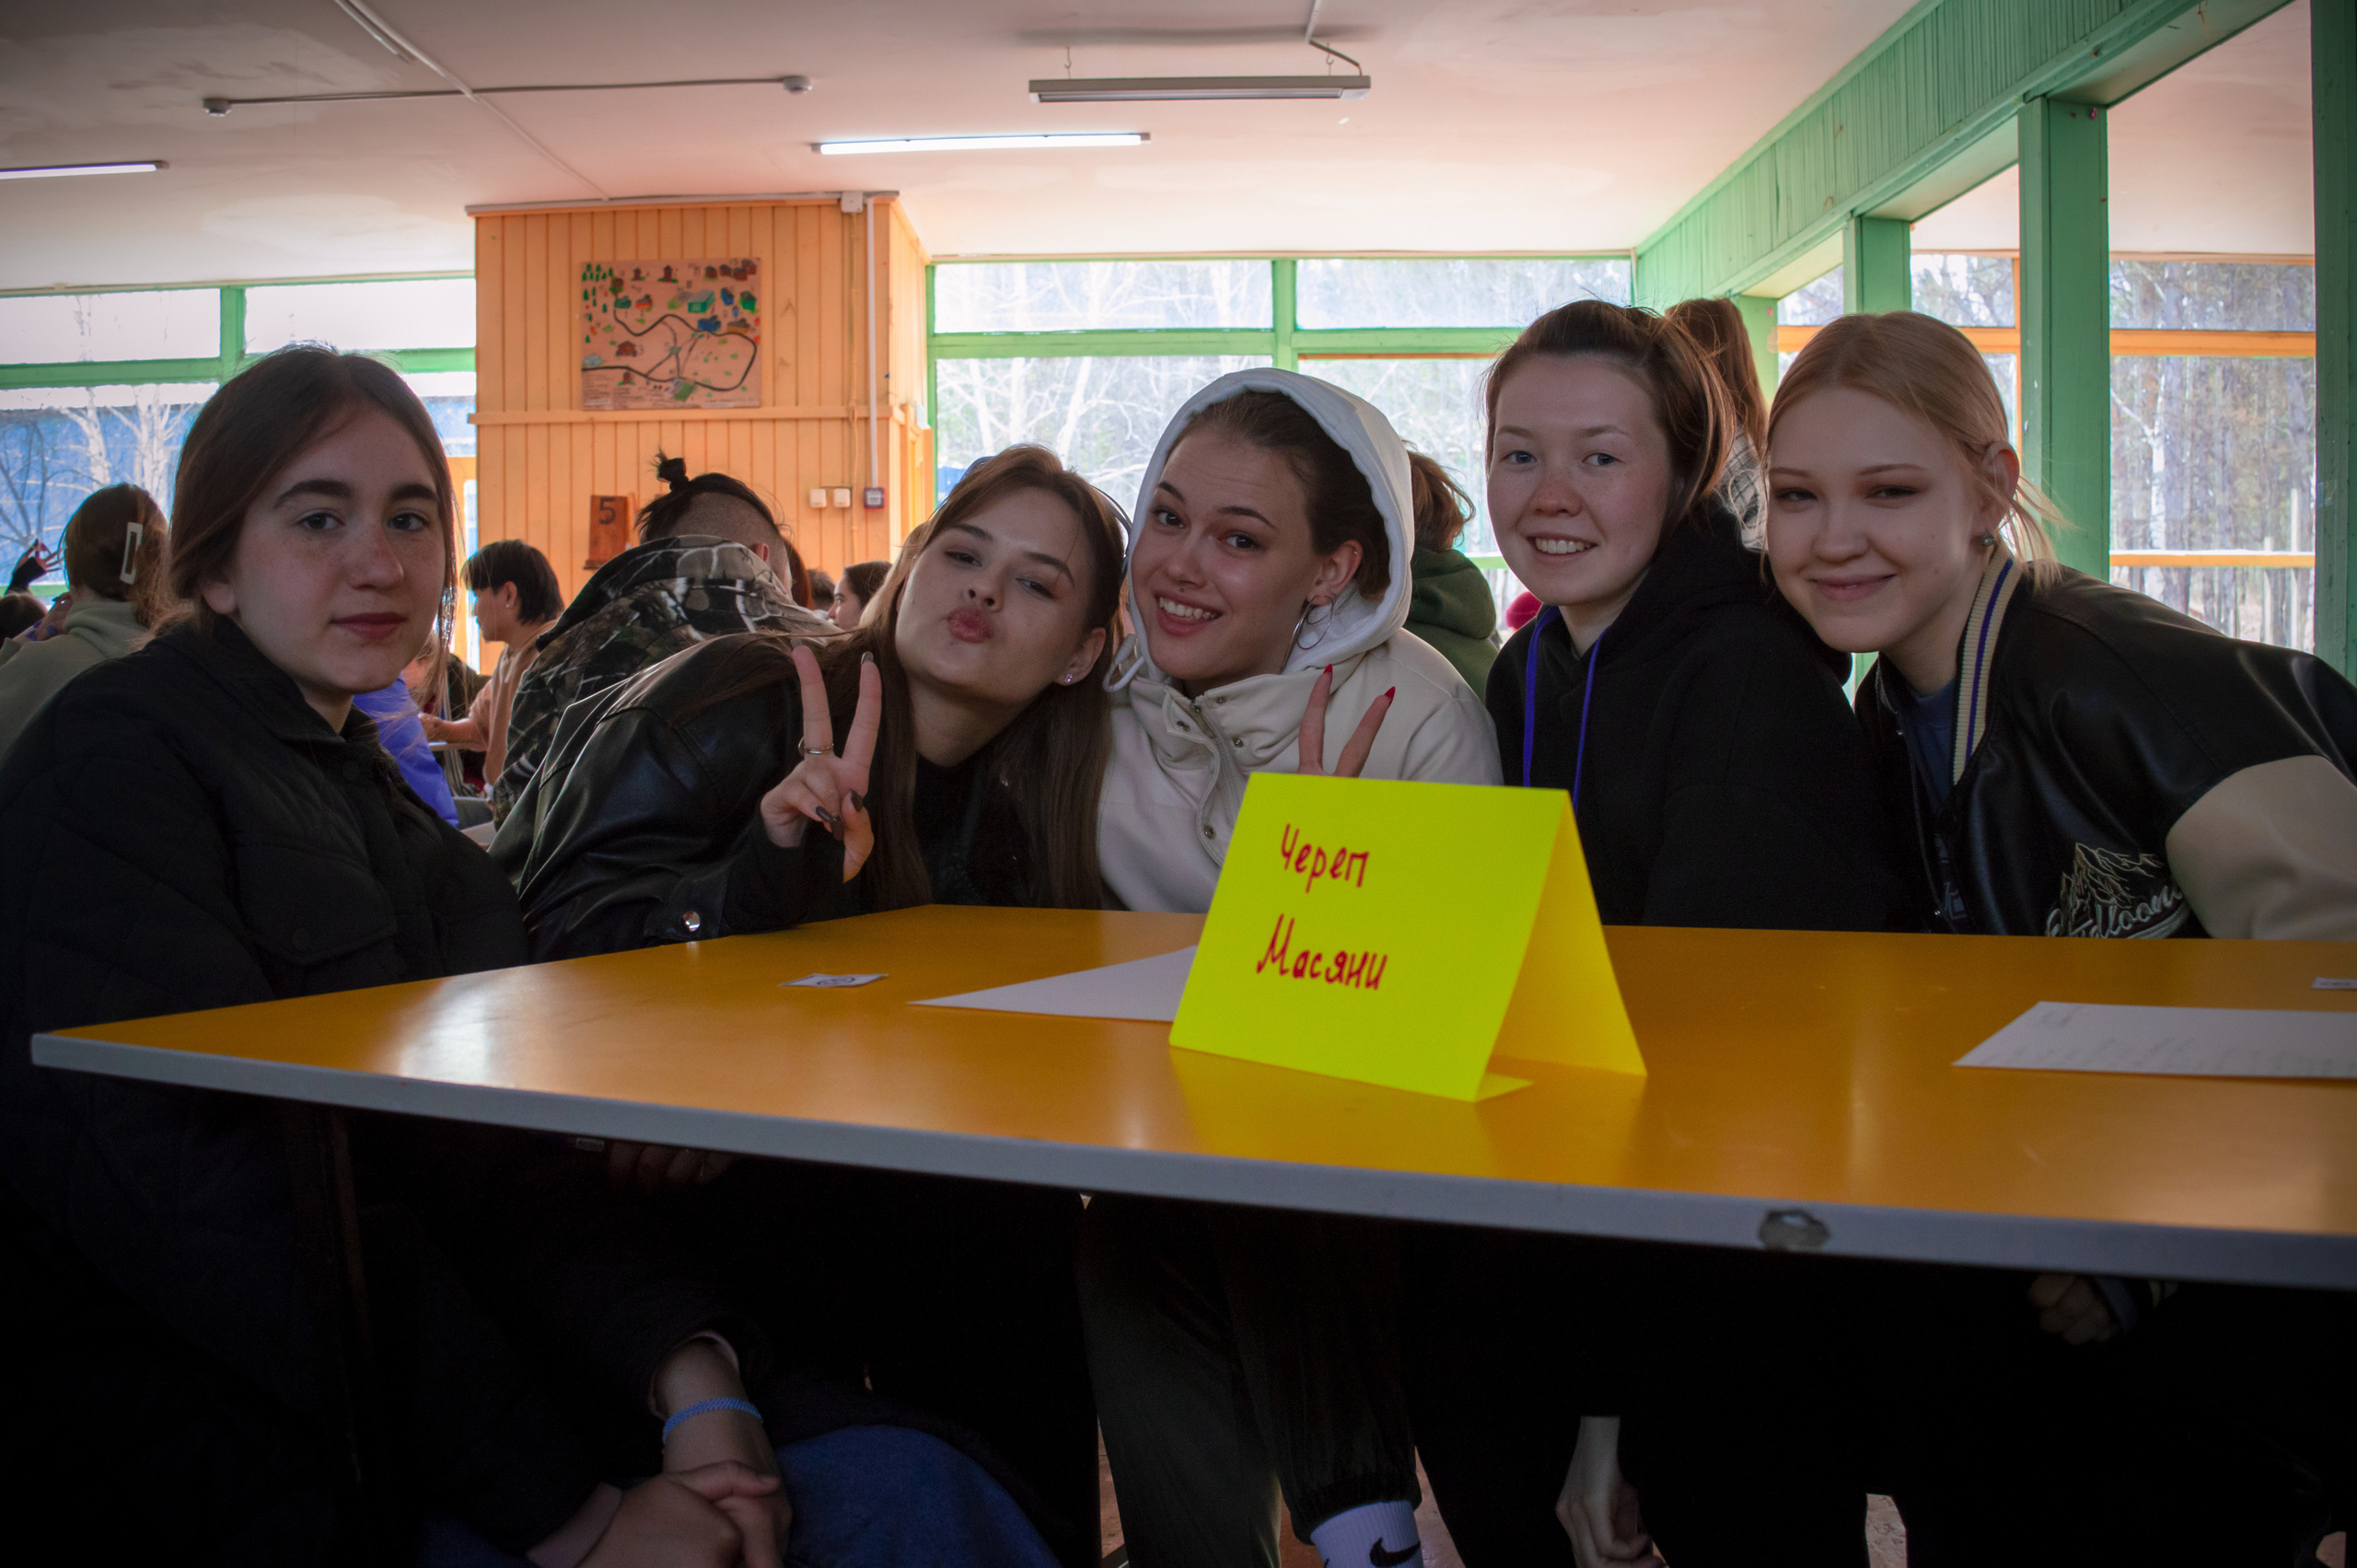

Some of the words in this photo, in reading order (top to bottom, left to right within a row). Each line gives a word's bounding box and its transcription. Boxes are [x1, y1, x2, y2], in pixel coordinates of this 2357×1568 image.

[598, 496, 616, 525] 5
[1280, 823, 1370, 893] Череп
[1256, 913, 1388, 990] Масяни
